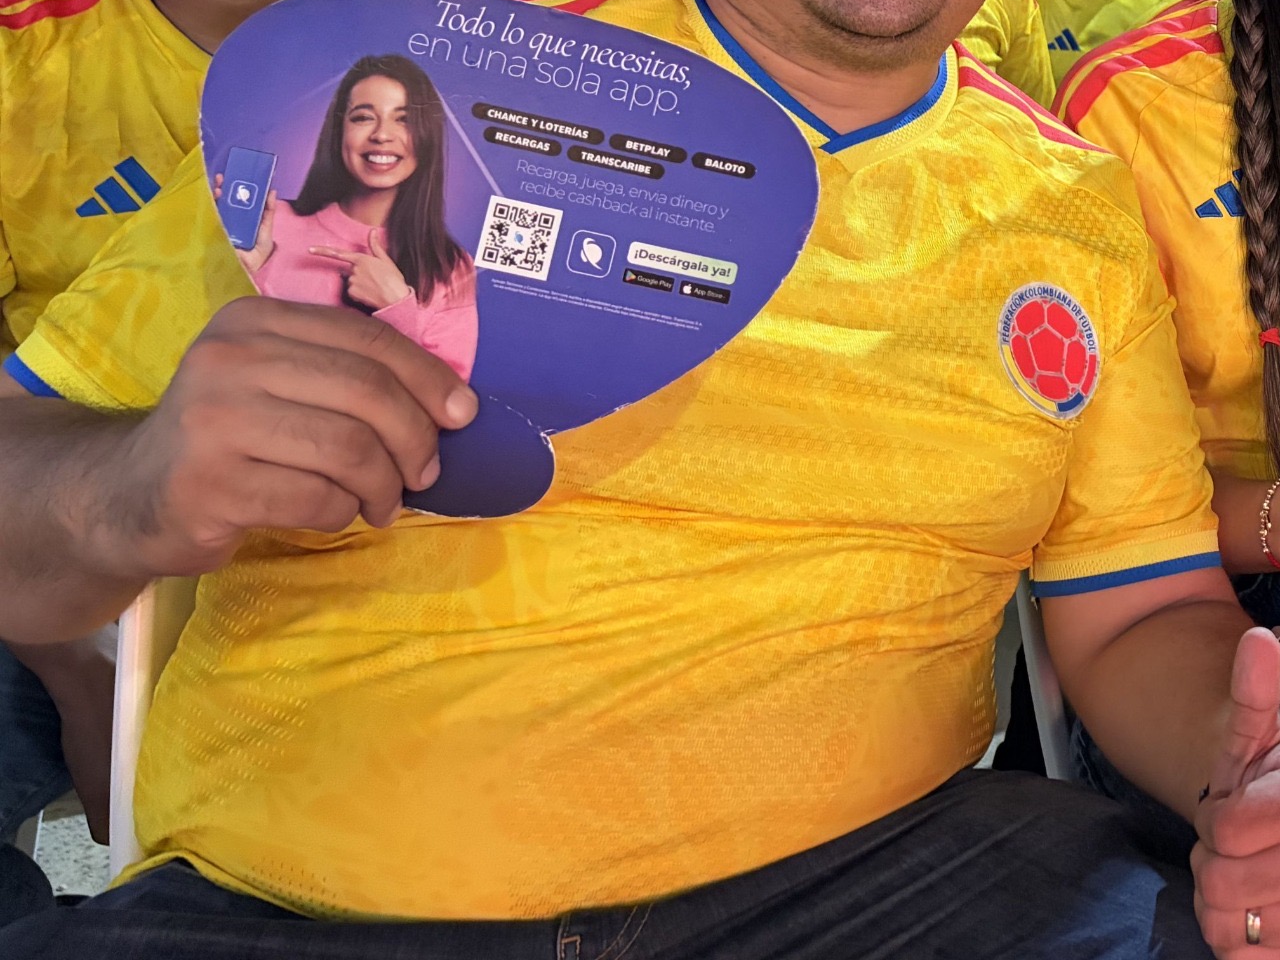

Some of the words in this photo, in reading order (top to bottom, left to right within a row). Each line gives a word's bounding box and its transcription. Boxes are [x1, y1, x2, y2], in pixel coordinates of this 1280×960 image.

[435, 0, 495, 38] Todo
[500, 13, 524, 45] lo
[528, 32, 576, 69] que
[580, 43, 690, 90] necesitas,
[407, 32, 452, 61] en
[462, 45, 527, 78] una
[534, 61, 601, 96] sola
[609, 79, 680, 116] app.
[487, 108, 528, 125] CHANCE
[531, 118, 539, 127] Y
[539, 120, 589, 139] LOTERÍAS
[494, 131, 550, 151] RECARGAS
[625, 140, 670, 157] BETPLAY
[581, 151, 651, 174] TRANSCARIBE
[704, 158, 746, 174] BALOTO
[516, 159, 578, 186] Recarga,
[578, 173, 626, 197] juega,
[669, 194, 718, 215] dinero
[717, 207, 729, 220] y
[519, 180, 565, 200] recibe
[567, 191, 638, 215] cashback
[639, 206, 653, 219] al
[655, 207, 715, 233] instante.
[634, 248, 709, 273] ¡Descárgala
[710, 266, 731, 277] ya!
[637, 275, 658, 285] Google
[658, 279, 672, 289] Play
[693, 287, 706, 296] App
[1024, 286, 1071, 307] COLOMBIANA
[1071, 303, 1082, 316] DE
